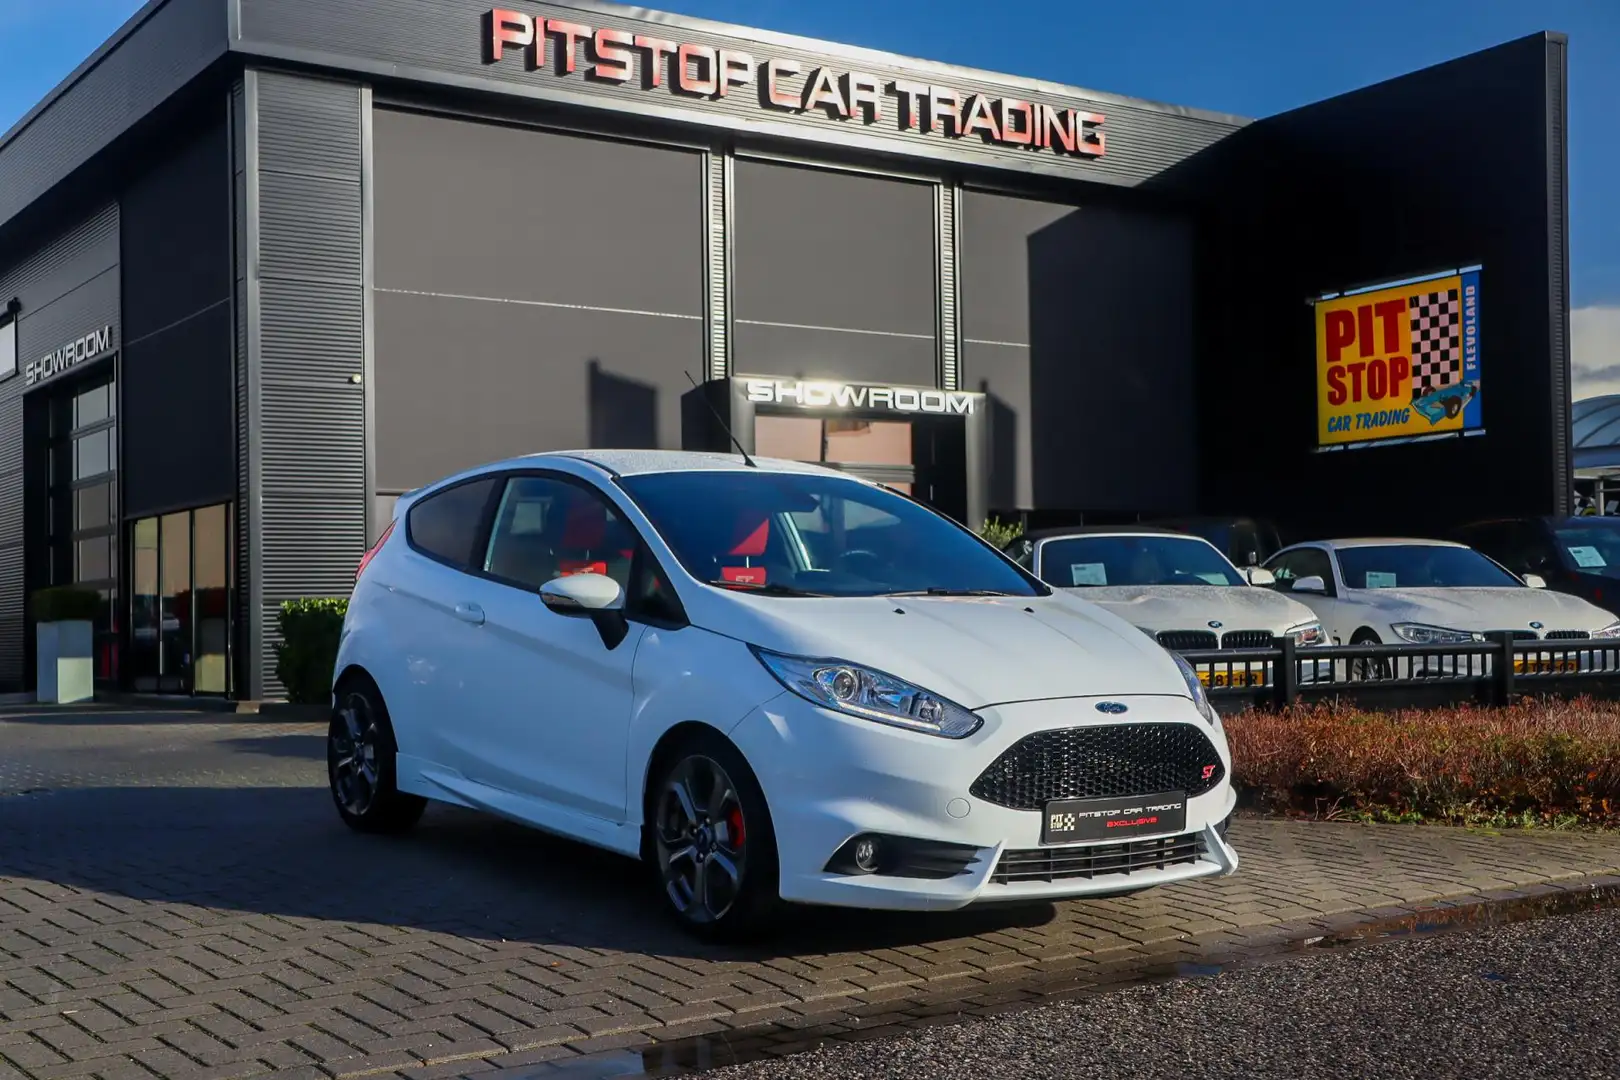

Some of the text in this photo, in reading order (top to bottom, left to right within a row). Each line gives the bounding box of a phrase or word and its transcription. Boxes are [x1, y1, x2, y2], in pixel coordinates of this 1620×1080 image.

[491, 8, 1106, 157] PITSTOP CAR TRADING
[1325, 297, 1406, 363] PIT
[1465, 285, 1477, 370] FLEVOLAND
[25, 325, 110, 386] SHOWROOM
[745, 381, 974, 415] SHOWROOM
[1326, 356, 1410, 406] STOP
[1327, 407, 1411, 433] CAR TRADING
[1050, 814, 1064, 822] PIT
[1078, 810, 1121, 818] PITSTOP
[1146, 803, 1182, 812] TRADING
[1106, 817, 1158, 827] EXCLUSIVE
